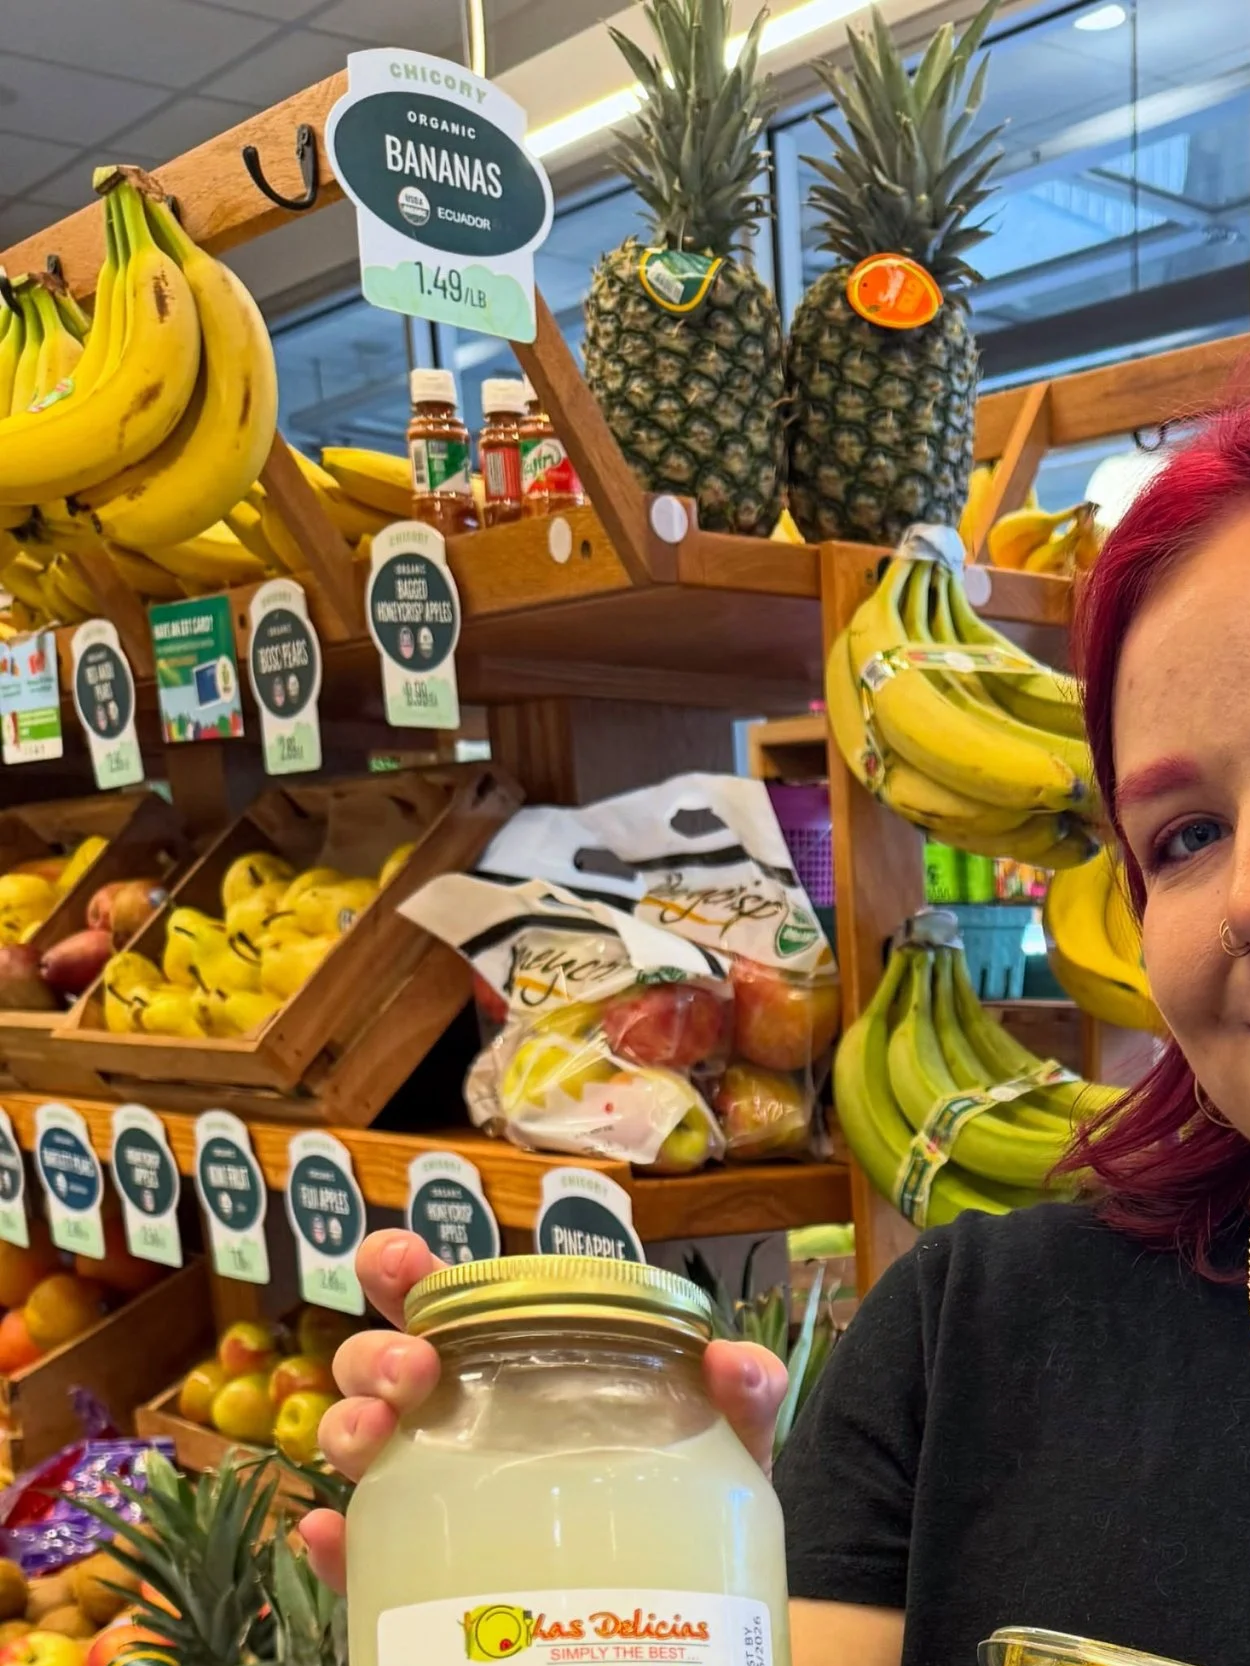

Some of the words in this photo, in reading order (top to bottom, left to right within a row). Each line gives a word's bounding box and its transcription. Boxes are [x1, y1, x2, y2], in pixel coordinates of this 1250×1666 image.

[389, 62, 488, 105] CHICORY
[406, 109, 477, 140] ORGANIC
[384, 134, 503, 199] BANANAS
[437, 206, 492, 231] ECUADOR
[414, 261, 488, 309] 1.49/LB
[554, 1225, 626, 1260] PINEAPPLE
[532, 1613, 586, 1642] Las
[588, 1608, 710, 1642] Delicias
[743, 1627, 754, 1647] BY
[550, 1648, 609, 1662] SIMPLY
[612, 1646, 644, 1660] THE
